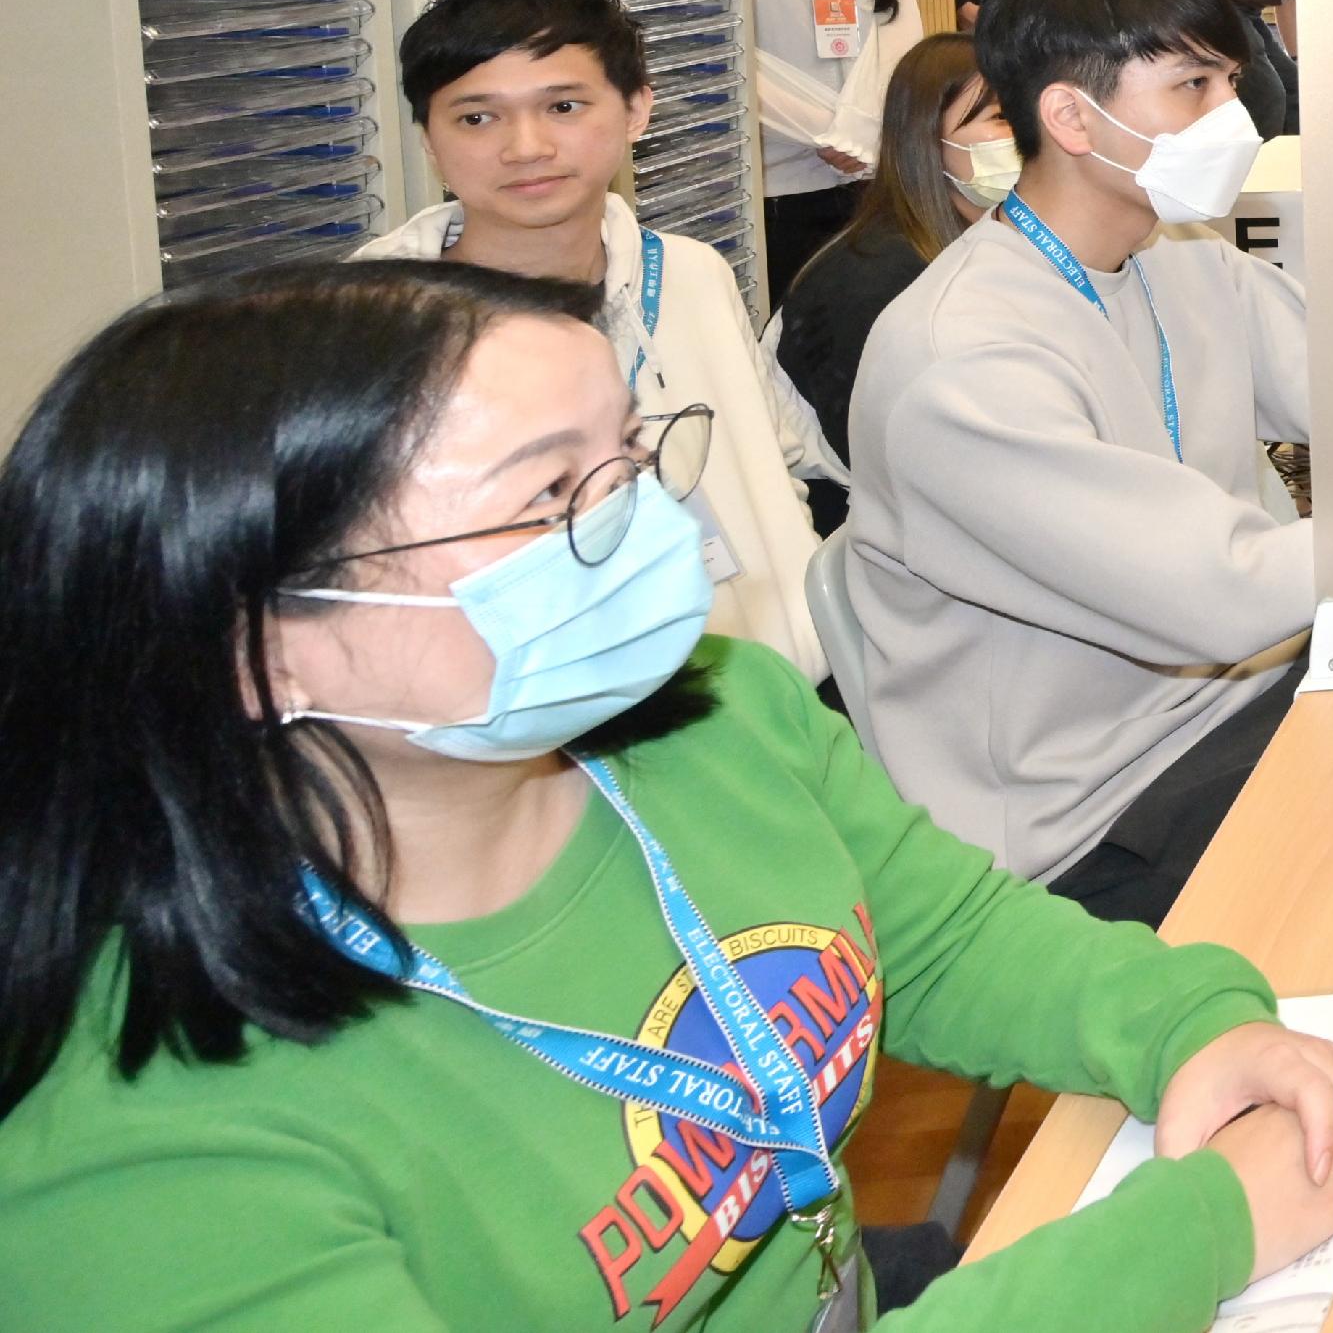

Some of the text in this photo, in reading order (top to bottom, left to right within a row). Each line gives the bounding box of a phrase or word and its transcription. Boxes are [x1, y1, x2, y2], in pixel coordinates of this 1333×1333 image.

[1009, 204, 1085, 288] ELECTORAL STAFF
[728, 926, 819, 959] BISCUITS
[647, 997, 680, 1040] ARE
[687, 927, 803, 1116] ELECTORAL STAFF
[578, 1044, 666, 1086] STAFF
